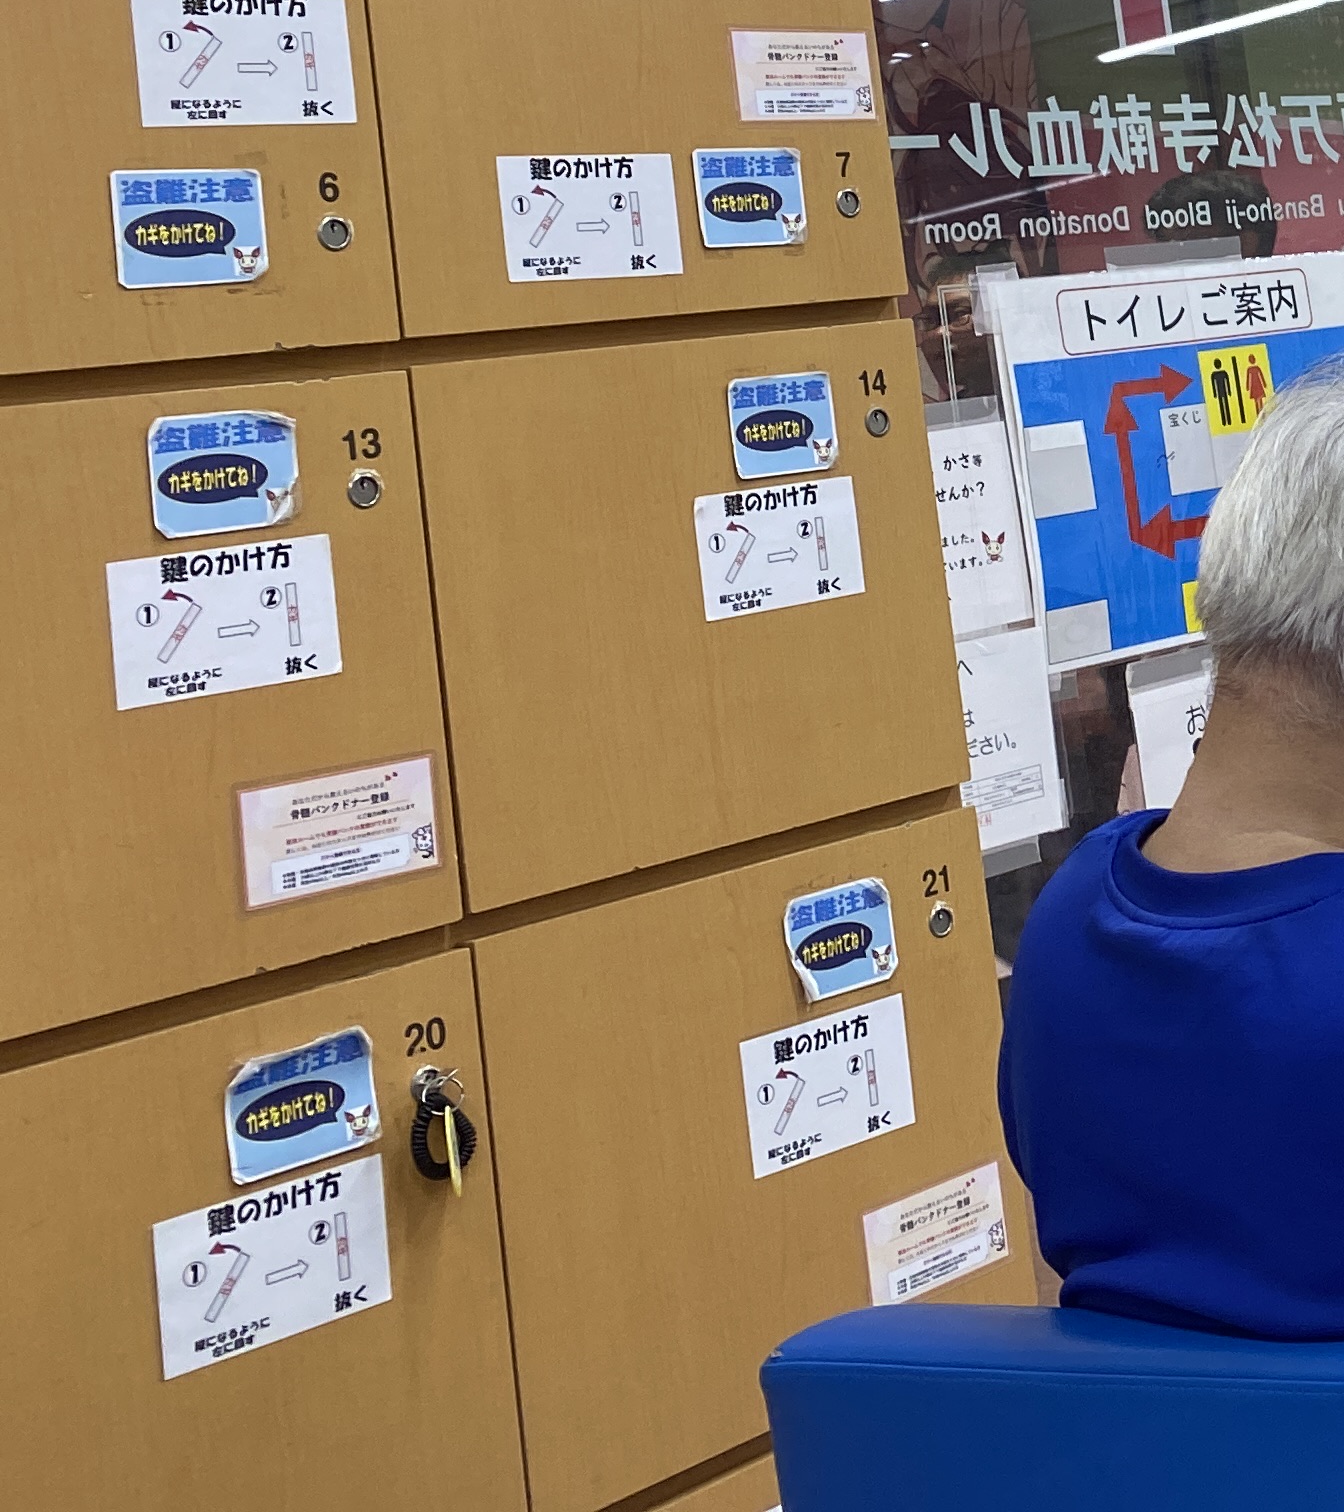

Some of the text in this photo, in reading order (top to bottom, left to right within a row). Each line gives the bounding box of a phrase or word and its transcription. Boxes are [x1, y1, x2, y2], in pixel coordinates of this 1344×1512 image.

[768, 53, 838, 61] 骨髄バンクドナー登録
[302, 100, 334, 117] 抜く
[530, 158, 634, 181] 鍵のかけ方
[701, 156, 796, 179] 盗難注意
[836, 152, 851, 177] 7
[121, 177, 254, 205] 盗難注意
[318, 172, 340, 202] 6
[630, 254, 658, 270] 抜く
[733, 380, 826, 410] 盗難注意
[859, 369, 887, 397] 14
[1168, 411, 1201, 427] 宝くじ
[342, 427, 382, 460] 13
[724, 483, 818, 517] 鍵のかけ方
[160, 543, 293, 585] 鍵のかけ方
[817, 576, 842, 595] 抜く
[285, 654, 318, 676] 抜く
[290, 790, 391, 821] 骨髄バンクドナー登録
[921, 865, 950, 898] 21
[404, 1017, 446, 1057] 20
[774, 1014, 869, 1065] 鍵のかけ方
[867, 1111, 892, 1134] 抜く
[207, 1171, 342, 1237] 鍵のかけ方
[334, 1284, 368, 1313] 抜く
